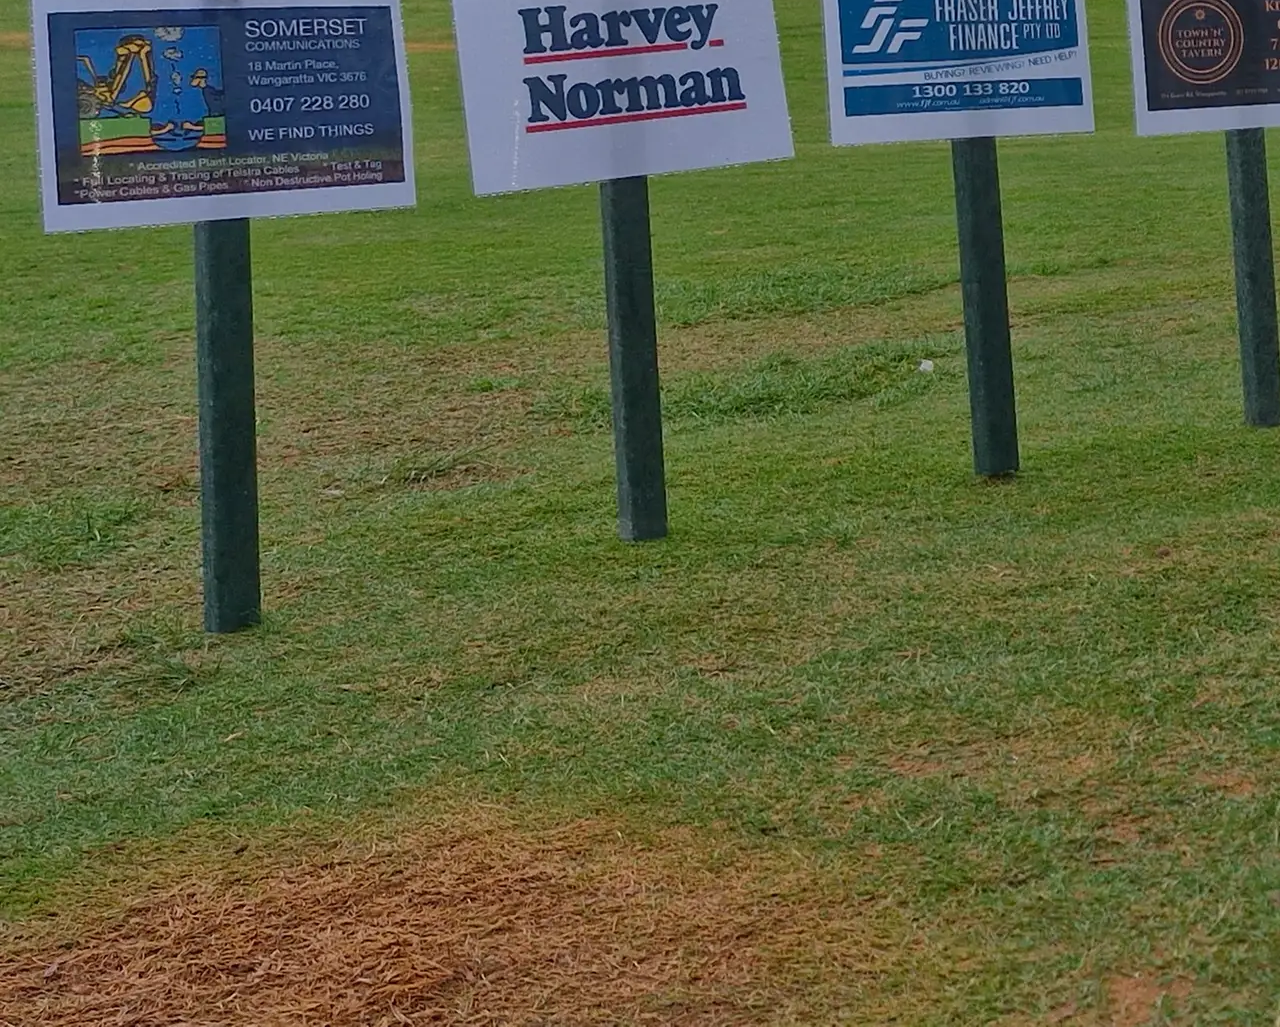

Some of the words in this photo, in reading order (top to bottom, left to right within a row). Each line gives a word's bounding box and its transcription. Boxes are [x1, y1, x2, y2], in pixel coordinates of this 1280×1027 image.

[245, 18, 368, 38] SOMERSET
[517, 3, 719, 54] Harvey
[1176, 29, 1208, 39] TOWN
[245, 38, 361, 52] COMMUNICATIONS
[949, 23, 1021, 52] FINANCE
[1023, 23, 1041, 40] PTY
[1045, 23, 1061, 39] LTD
[1175, 38, 1226, 48] COUNTRY
[1270, 38, 1278, 50] 7
[1181, 48, 1222, 59] TAVERN
[248, 61, 262, 71] 18
[265, 59, 302, 71] Martin
[923, 68, 966, 81] BUYING?
[968, 60, 1026, 76] REVIEWING?
[1028, 56, 1052, 66] NEED
[1053, 50, 1078, 61] HELP?
[248, 74, 315, 87] Wangaratta
[317, 73, 338, 82] VIC
[523, 65, 746, 123] Norman
[912, 84, 957, 98] 1300
[963, 83, 993, 96] 133
[998, 81, 1031, 94] 820
[250, 98, 295, 113] 0407
[300, 96, 334, 111] 228
[338, 94, 371, 110] 280
[896, 98, 960, 109] www.fjf.com.au
[248, 128, 274, 141] WE
[279, 126, 315, 140] FIND
[318, 123, 374, 138] THINGS
[137, 158, 196, 171] Accredited
[199, 157, 226, 169] Plant
[272, 153, 289, 163] NE
[290, 152, 329, 162] Victoria
[107, 174, 155, 186] Locating
[158, 173, 167, 182] &
[171, 170, 210, 182] Tracing
[212, 168, 225, 178] of
[227, 167, 261, 178] Telstra
[264, 165, 300, 175] Cables
[330, 161, 352, 171] Test
[354, 160, 362, 169] &
[364, 160, 382, 171] Tag
[119, 185, 159, 196] Cables
[162, 184, 171, 193] &
[174, 182, 197, 192] Gas
[199, 180, 229, 192] Pipes
[251, 178, 273, 188] Non
[275, 175, 333, 186] Destructive
[335, 173, 351, 182] Pot
[353, 171, 383, 182] Holing
